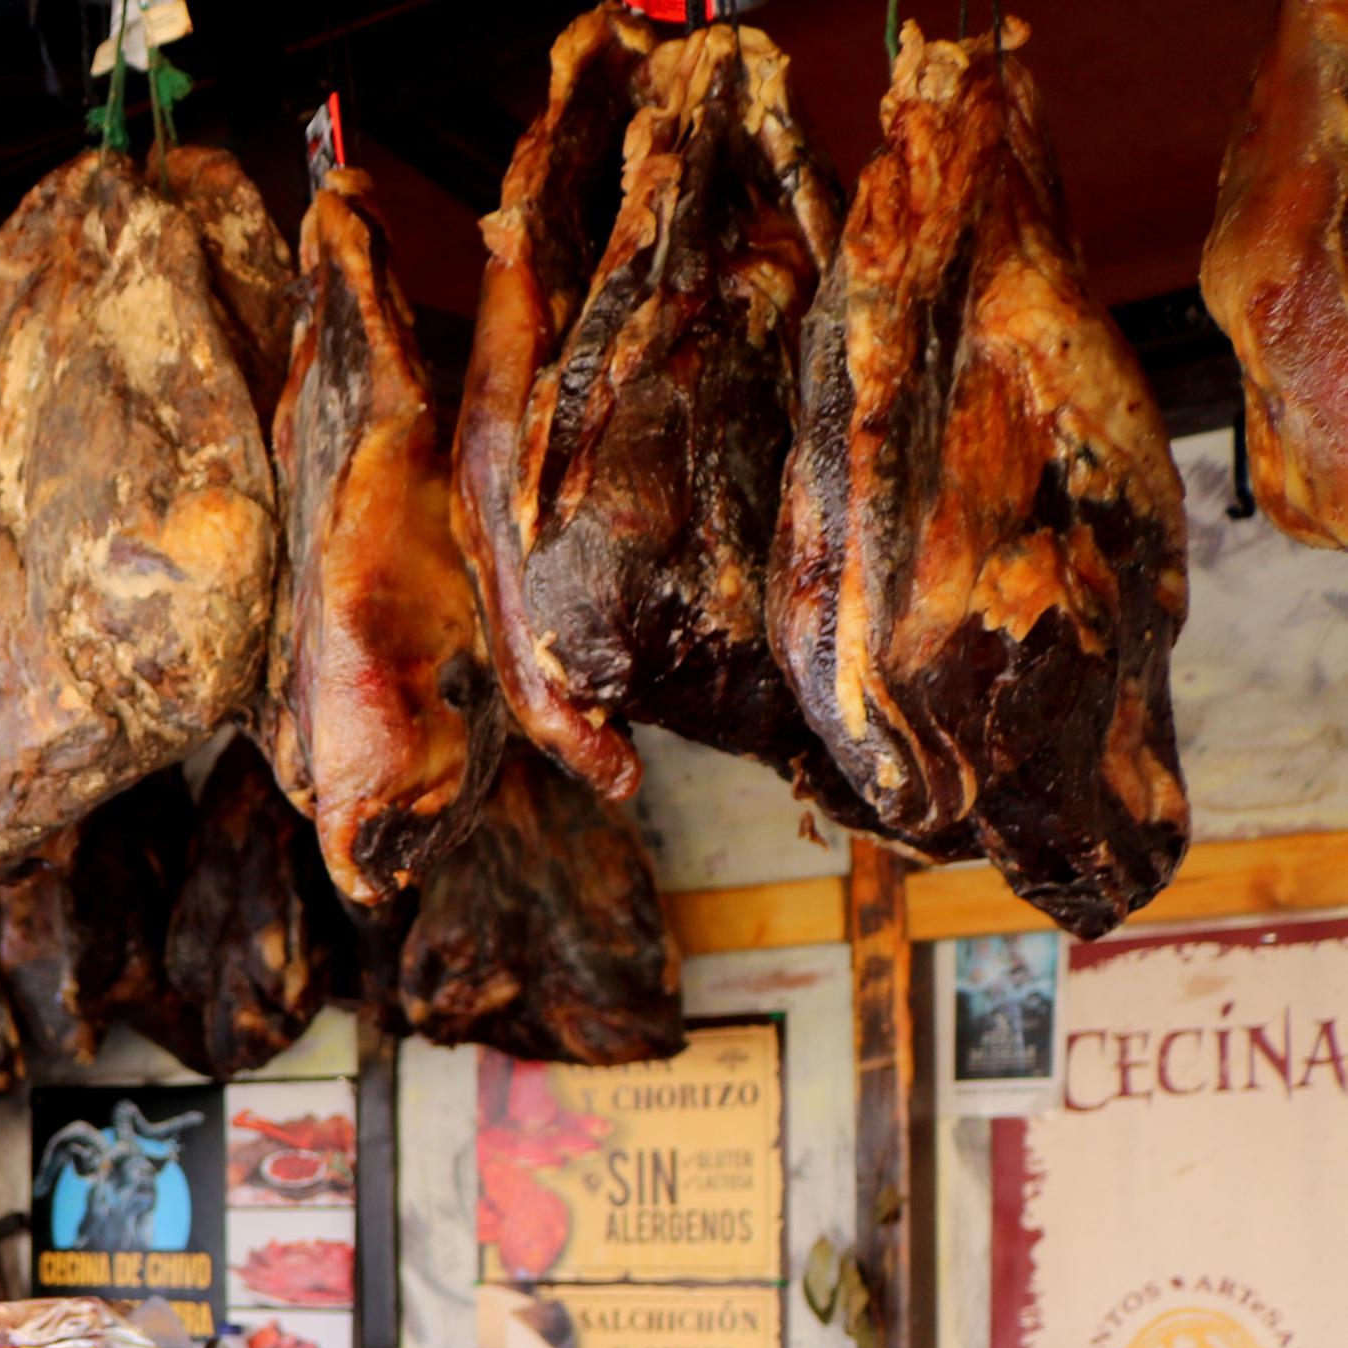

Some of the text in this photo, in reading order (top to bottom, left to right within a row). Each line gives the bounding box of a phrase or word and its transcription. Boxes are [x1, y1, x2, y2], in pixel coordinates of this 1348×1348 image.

[611, 1079, 760, 1111] CHORIZO
[608, 1148, 678, 1206] SIN
[39, 1251, 213, 1289] CECINA DE CHIVO
[579, 1304, 759, 1332] SALCHICHÓN
